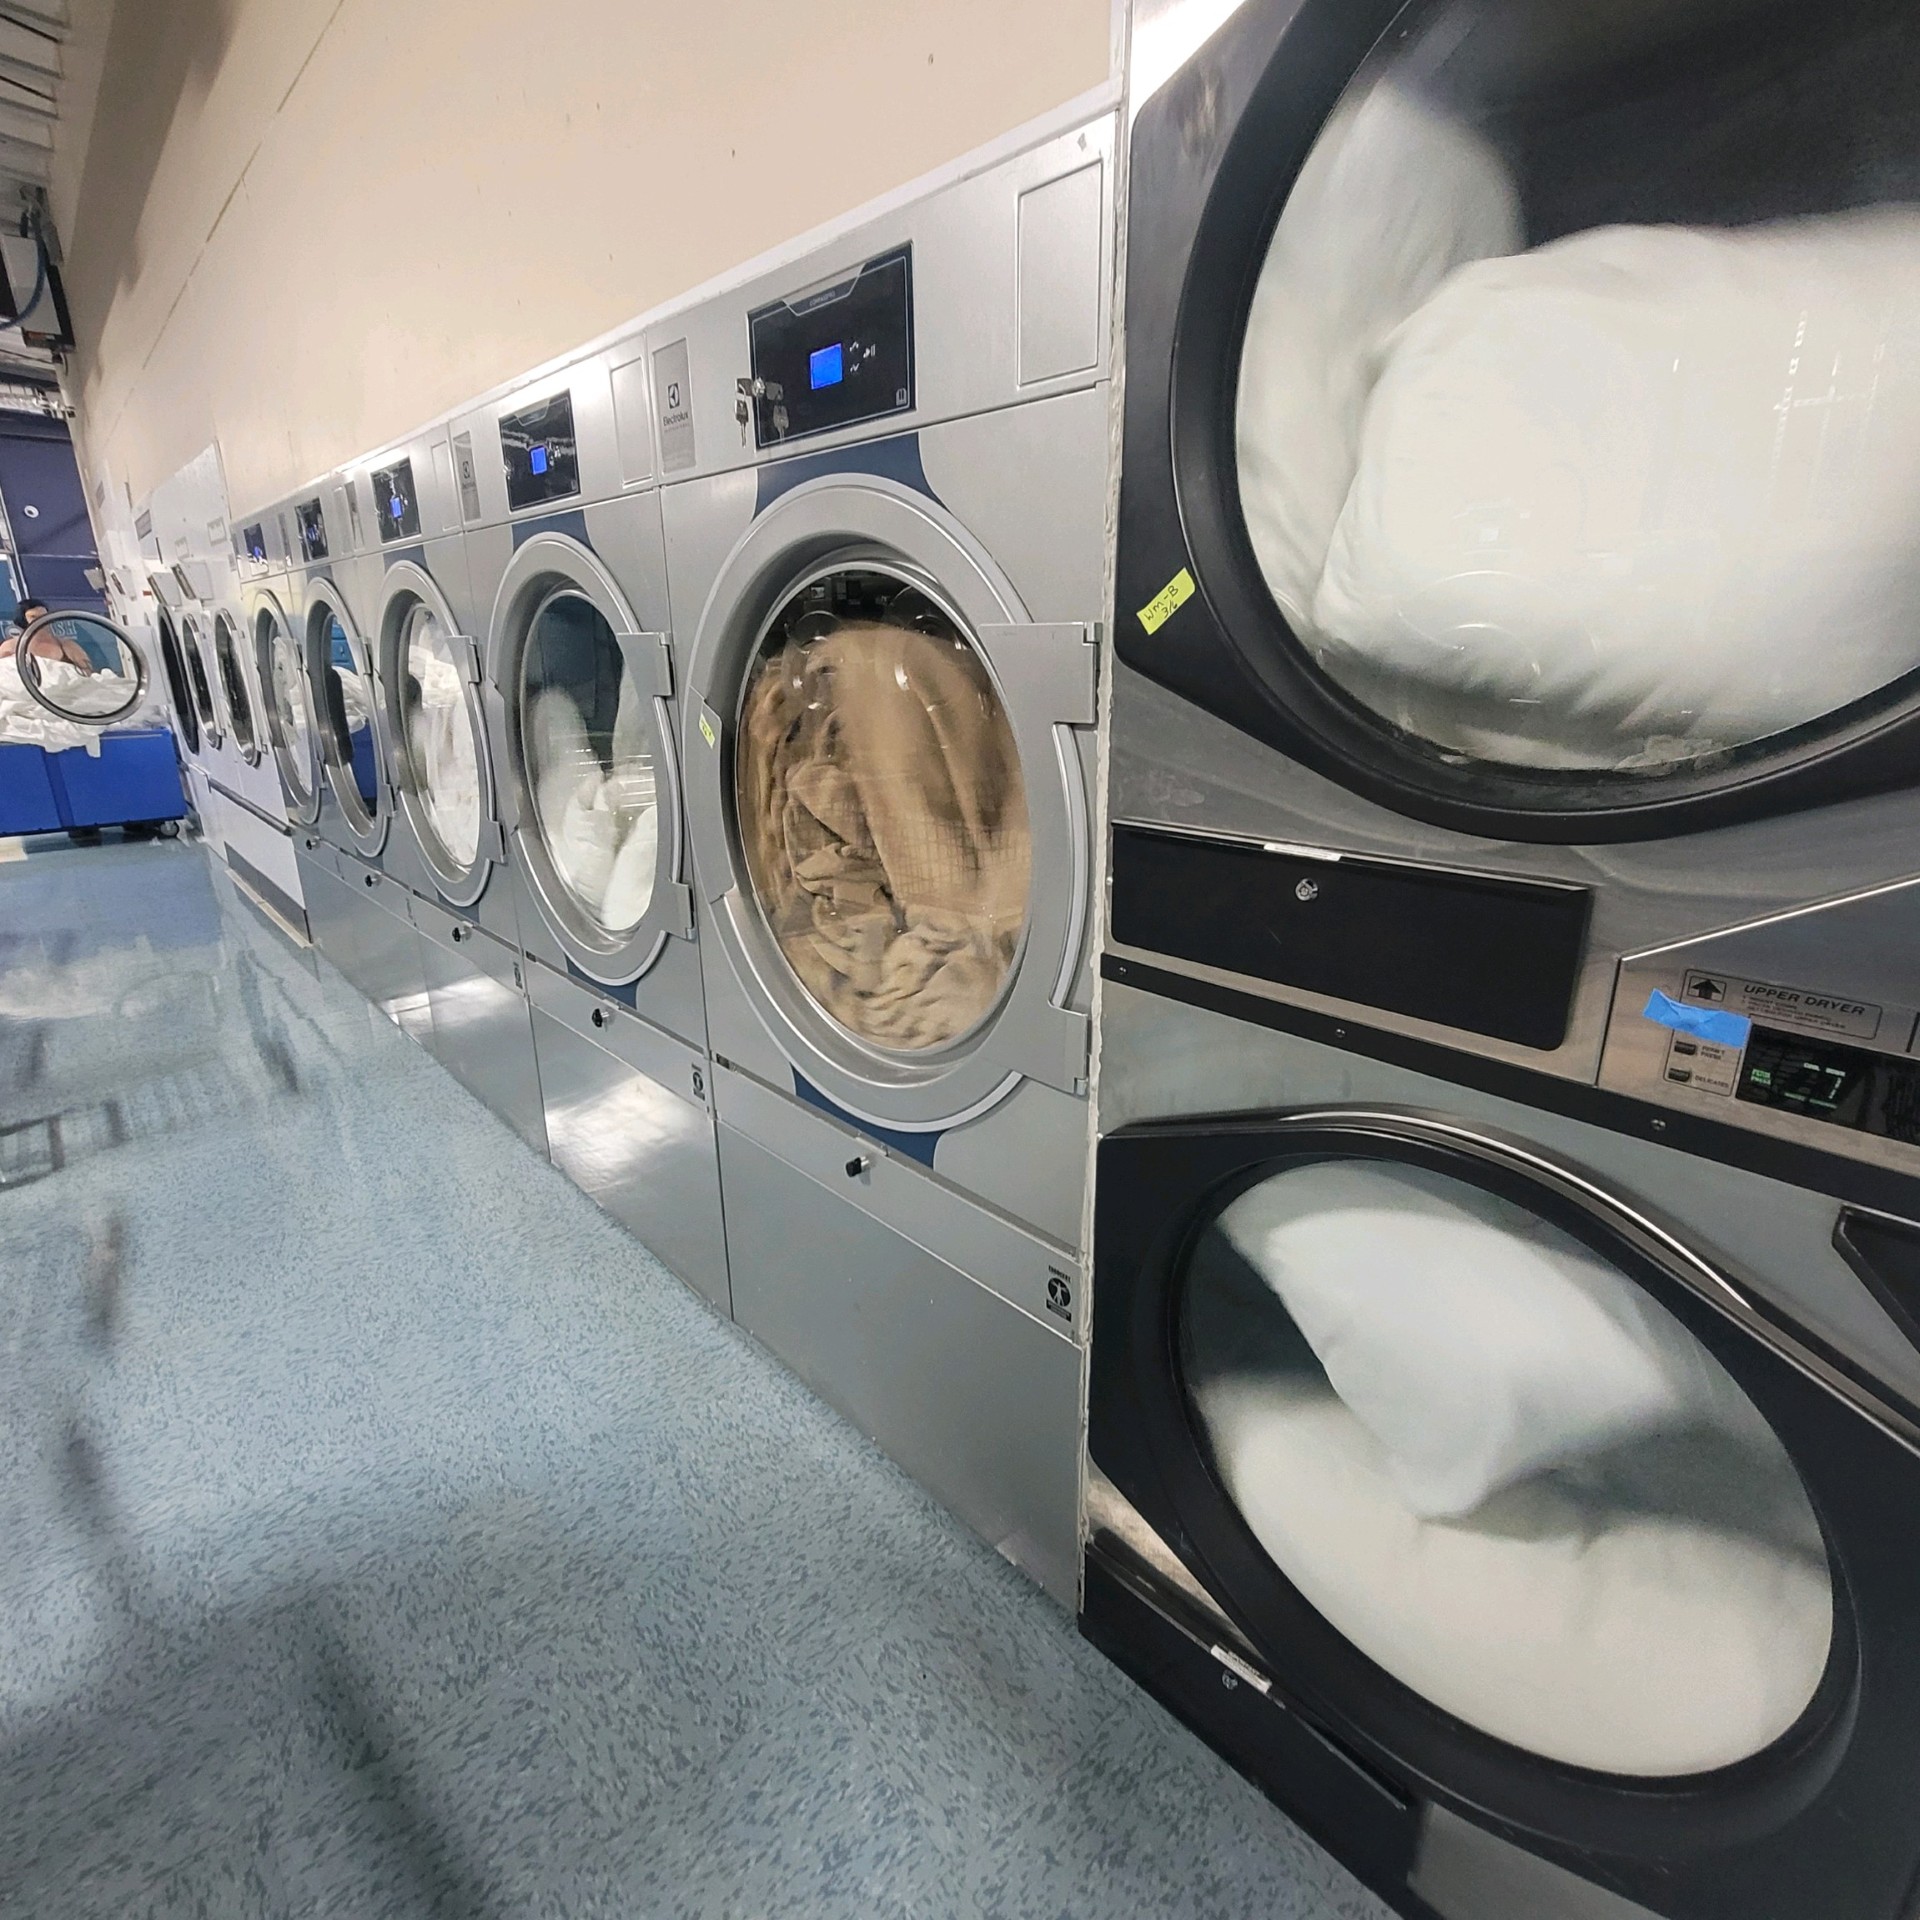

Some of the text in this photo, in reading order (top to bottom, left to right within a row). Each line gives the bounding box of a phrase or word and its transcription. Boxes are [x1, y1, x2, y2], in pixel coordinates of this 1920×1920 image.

[663, 411, 689, 427] Electrolux
[1744, 984, 1801, 1002] UPPER
[1804, 997, 1865, 1016] DRYER
